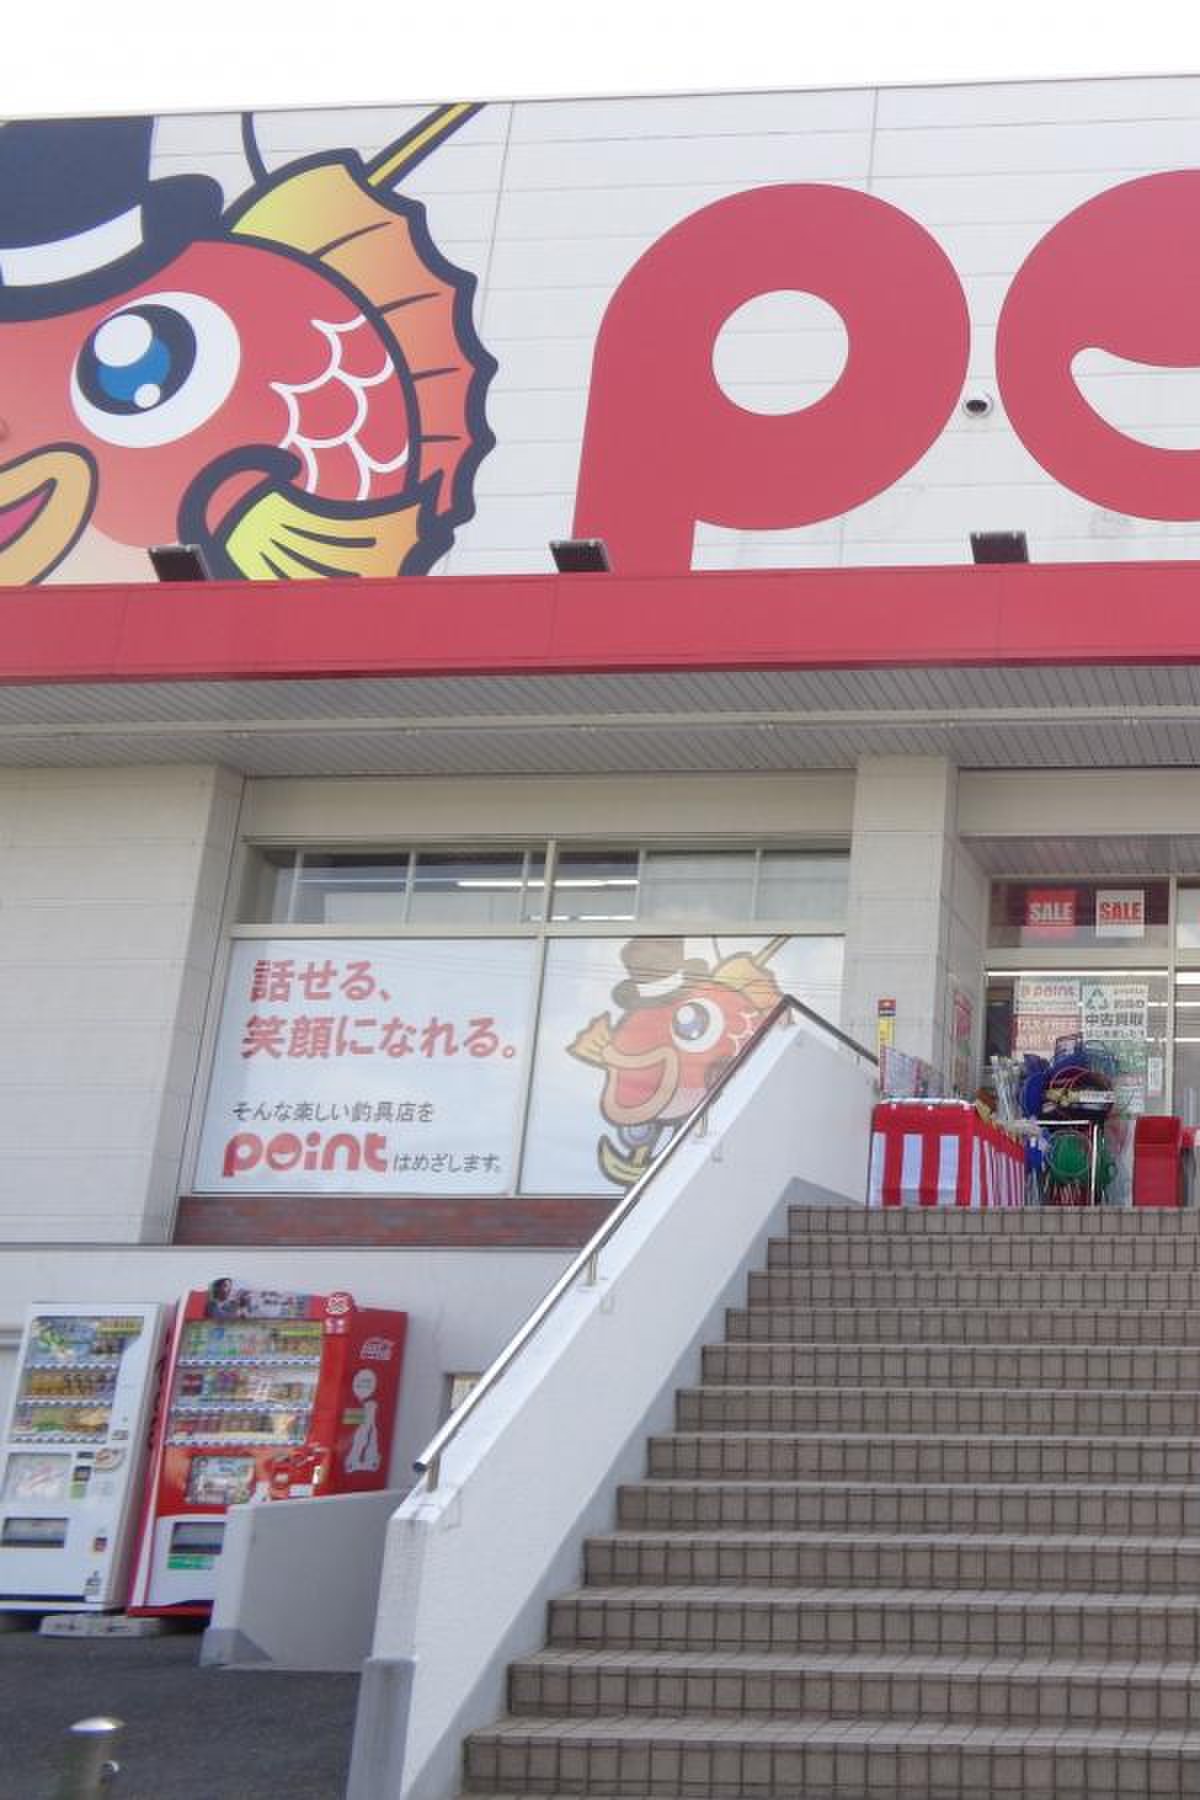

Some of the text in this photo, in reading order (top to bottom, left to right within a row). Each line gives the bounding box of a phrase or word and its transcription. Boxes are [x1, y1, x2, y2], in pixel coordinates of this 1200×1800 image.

[1029, 902, 1073, 921] SALE
[1102, 901, 1143, 920] SALE
[249, 959, 391, 1003] 話せる、
[240, 1014, 517, 1059] 笑顔になれる。
[231, 1101, 434, 1123] そんな楽しい釣具店を
[222, 1131, 388, 1178] point
